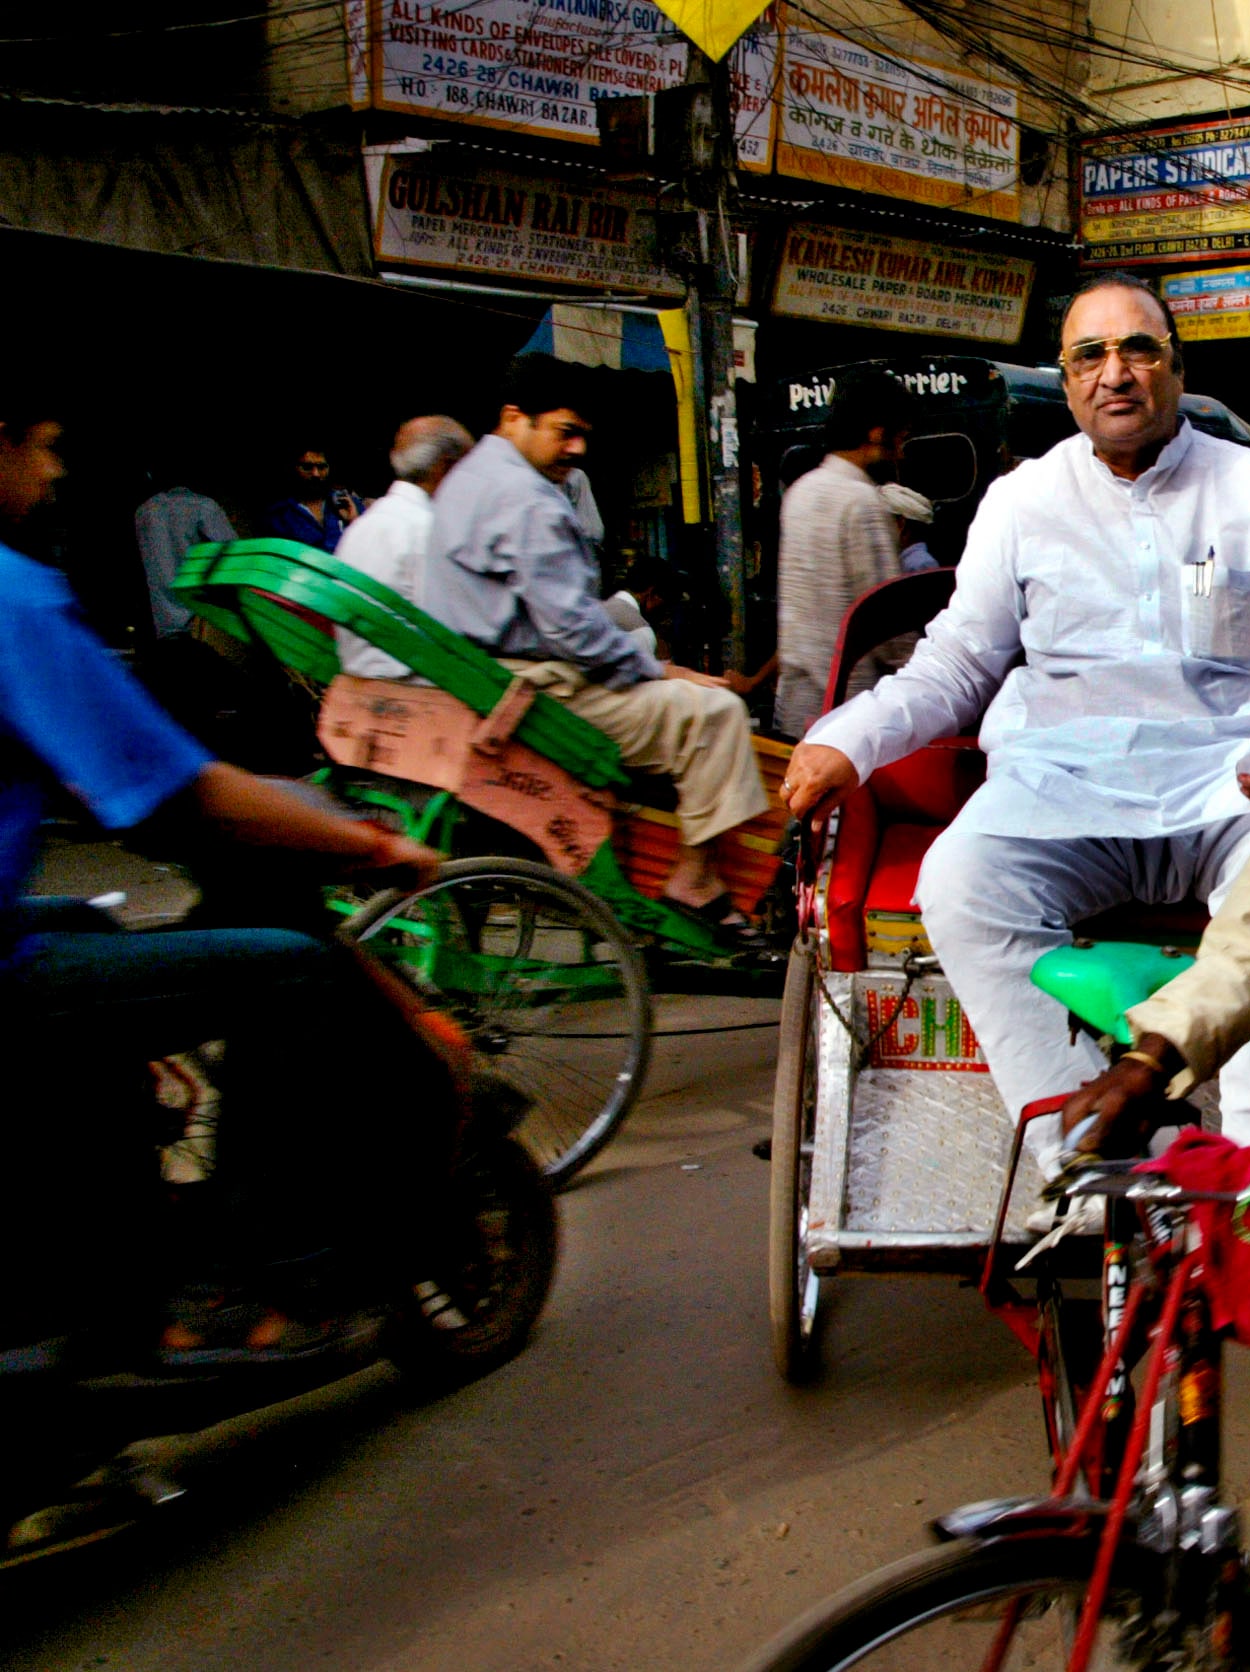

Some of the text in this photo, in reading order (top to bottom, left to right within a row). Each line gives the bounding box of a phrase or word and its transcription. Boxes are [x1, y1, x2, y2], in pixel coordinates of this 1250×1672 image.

[388, 21, 457, 51] VISITING
[461, 37, 504, 62] CARDS
[392, 1, 425, 23] ALL
[430, 9, 484, 36] KINDS
[490, 20, 511, 40] OF
[615, 48, 657, 72] COVERS
[508, 71, 578, 99] CHAWRI
[787, 60, 859, 112] कमलेश
[863, 79, 907, 123] कुमार
[912, 90, 960, 138] अनिल
[964, 108, 1012, 150] कुमार
[1084, 155, 1159, 195] PAPERS
[389, 170, 527, 228] GULSHAN
[1119, 199, 1134, 212] ALL
[1136, 196, 1162, 210] KINDS
[411, 215, 446, 232] PAPER
[788, 236, 874, 274] KAMLESH
[876, 250, 930, 284] KUMAR
[797, 268, 867, 291] WHOLESALE
[871, 279, 906, 297] PAPER
[916, 285, 952, 304] BOARD
[953, 290, 1013, 312] MERCHANTS
